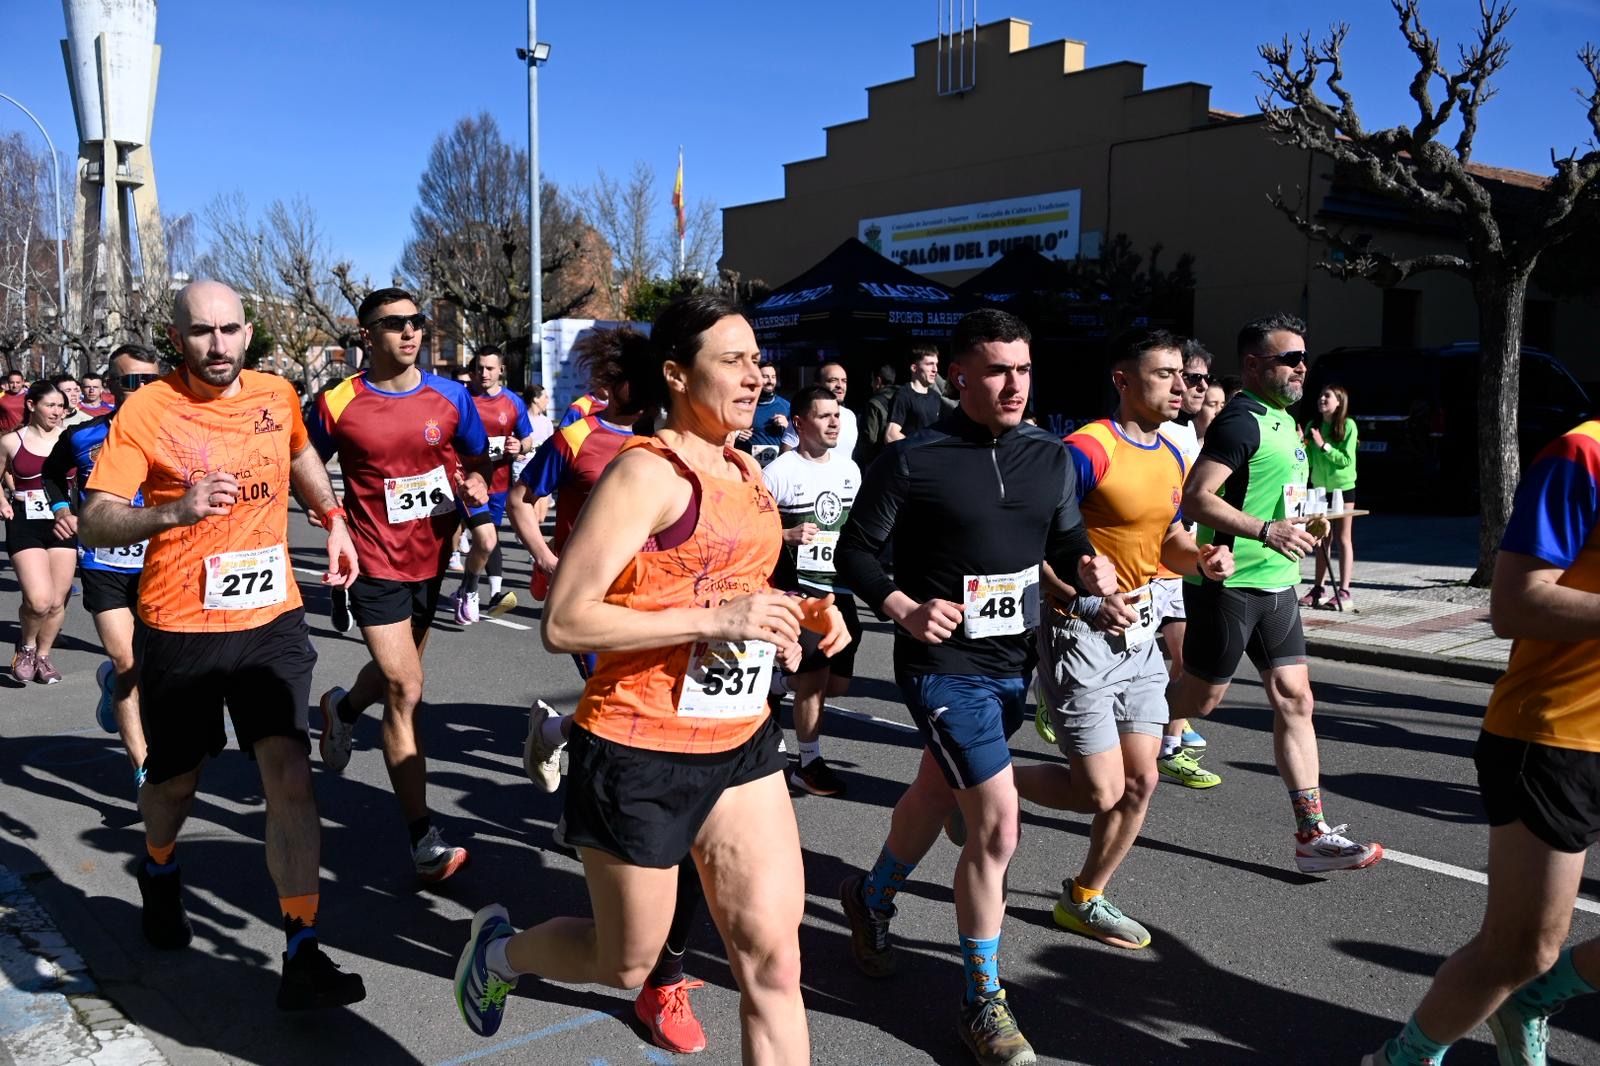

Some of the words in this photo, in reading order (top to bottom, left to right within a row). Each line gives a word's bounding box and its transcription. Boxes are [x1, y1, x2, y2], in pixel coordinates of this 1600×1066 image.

[954, 241, 984, 261] DEL
[888, 311, 923, 324] SPORTS
[399, 487, 443, 510] 316
[222, 569, 274, 597] 272
[1139, 606, 1153, 628] 5
[703, 666, 760, 696] 537
